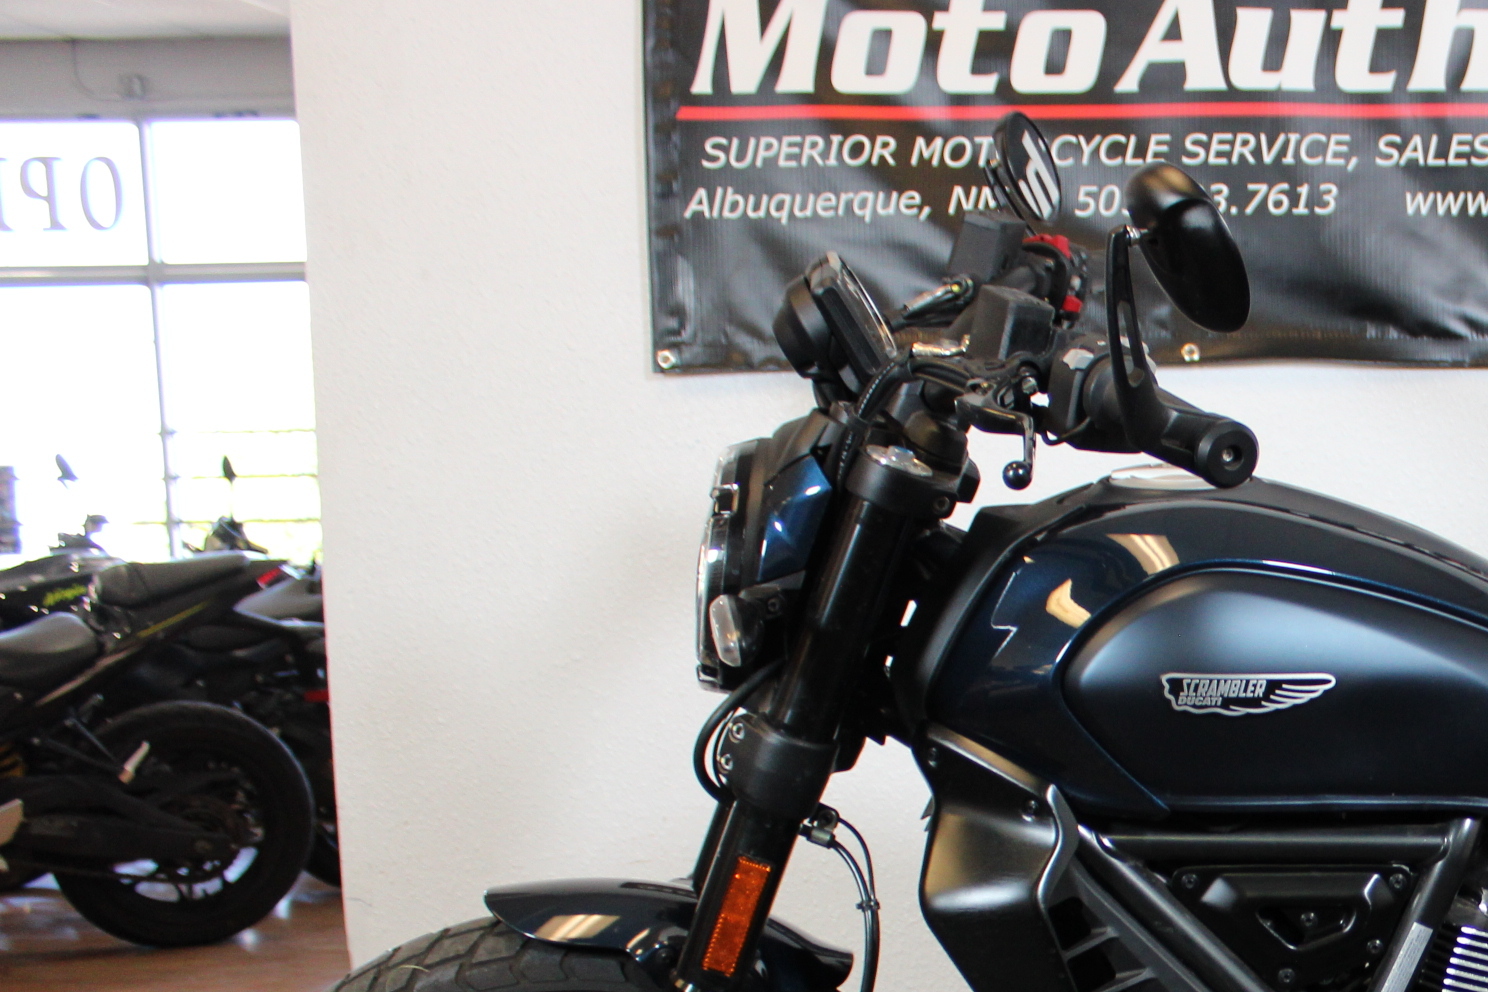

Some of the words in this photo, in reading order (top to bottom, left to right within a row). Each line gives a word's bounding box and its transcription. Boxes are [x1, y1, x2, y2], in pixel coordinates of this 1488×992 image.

[690, 0, 1107, 94] Moto
[701, 134, 897, 169] SUPERIOR
[910, 134, 1171, 168] MOTCYCLE
[1181, 132, 1359, 171] SERVICE,
[684, 186, 932, 225] Albuquerque,
[1177, 696, 1222, 706] DUCATI
[1180, 679, 1267, 697] SCRAMBLER
